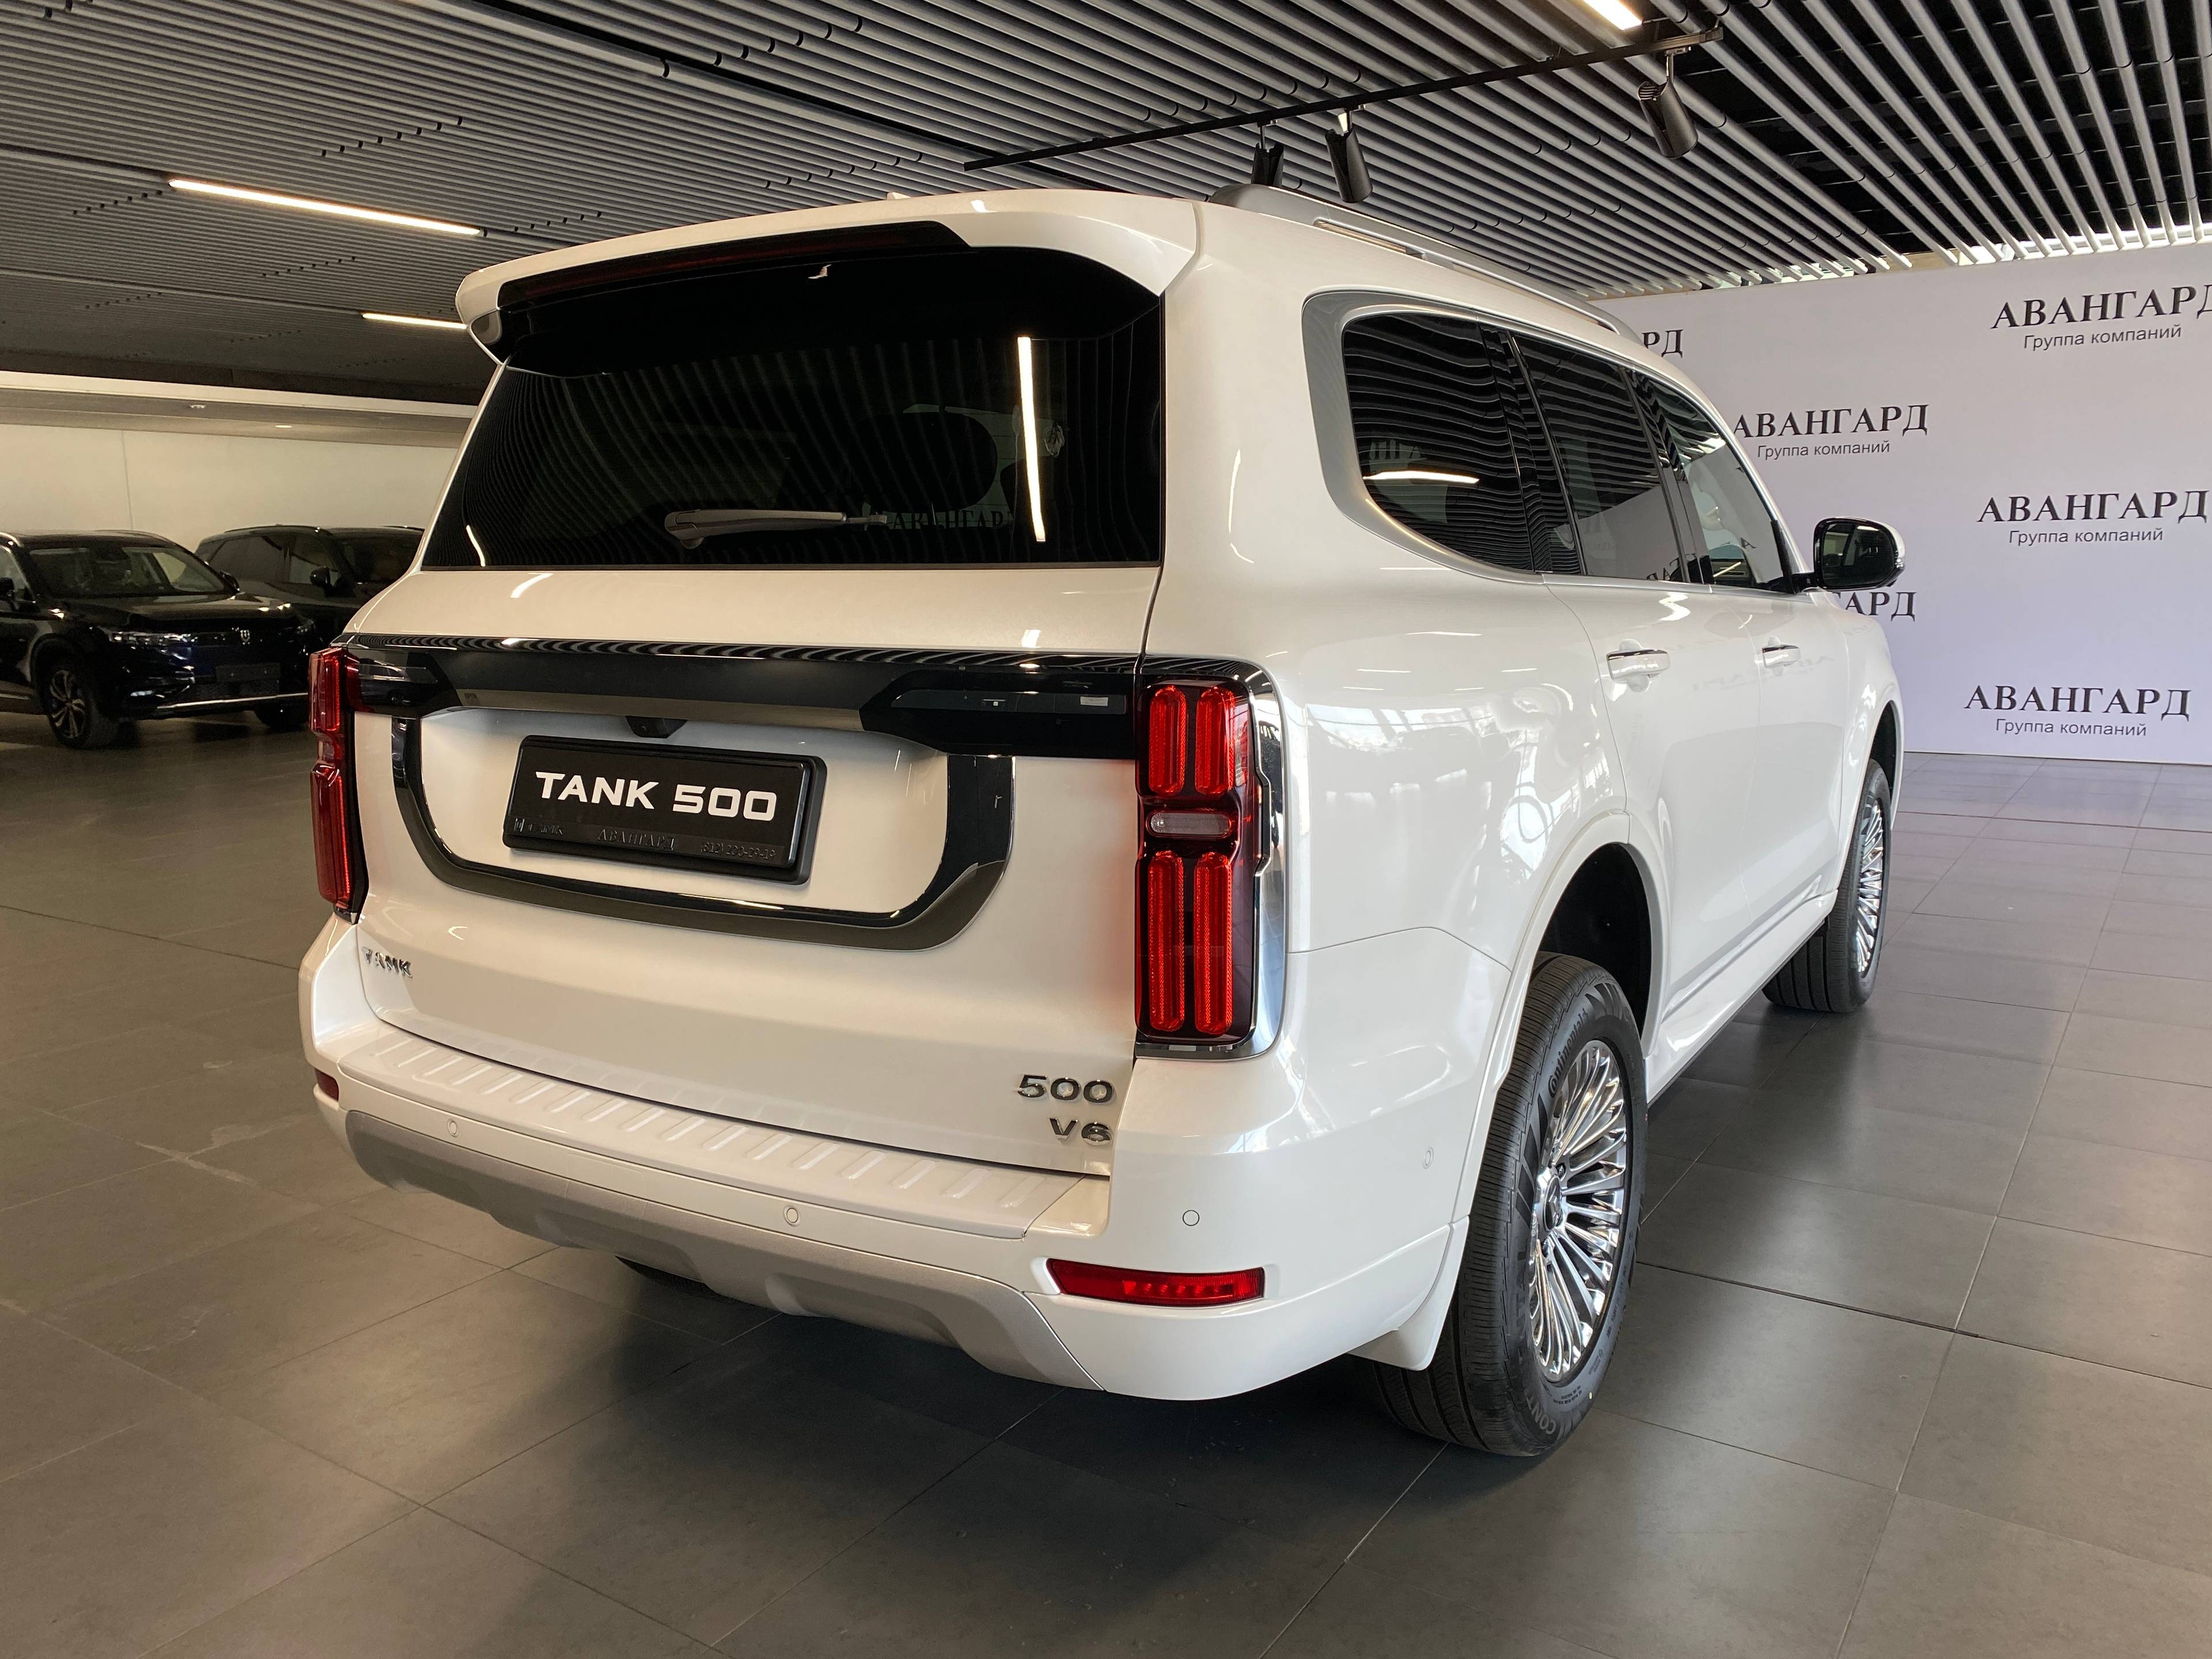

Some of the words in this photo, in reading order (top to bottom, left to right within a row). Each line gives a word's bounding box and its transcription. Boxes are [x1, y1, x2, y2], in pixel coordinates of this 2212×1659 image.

[2024, 334, 2085, 351] Группа
[2091, 324, 2182, 344] компаний
[1733, 404, 1930, 438] АВАНГАРД
[1757, 445, 1809, 461] Группа
[1814, 440, 1891, 457] компаний
[1976, 490, 2210, 524] АВАНГАРД
[2009, 530, 2068, 547] Группа
[2075, 528, 2164, 543] компаний
[1963, 685, 2192, 722] АВАНГАРД
[1995, 718, 2054, 735] Группа
[2061, 722, 2147, 737] компаний
[535, 771, 660, 810] TANK
[672, 783, 778, 822] 500
[361, 946, 413, 979] TANK
[1547, 1013, 1585, 1099] Continental
[1016, 1073, 1116, 1104] 500
[1049, 1116, 1113, 1146] V6
